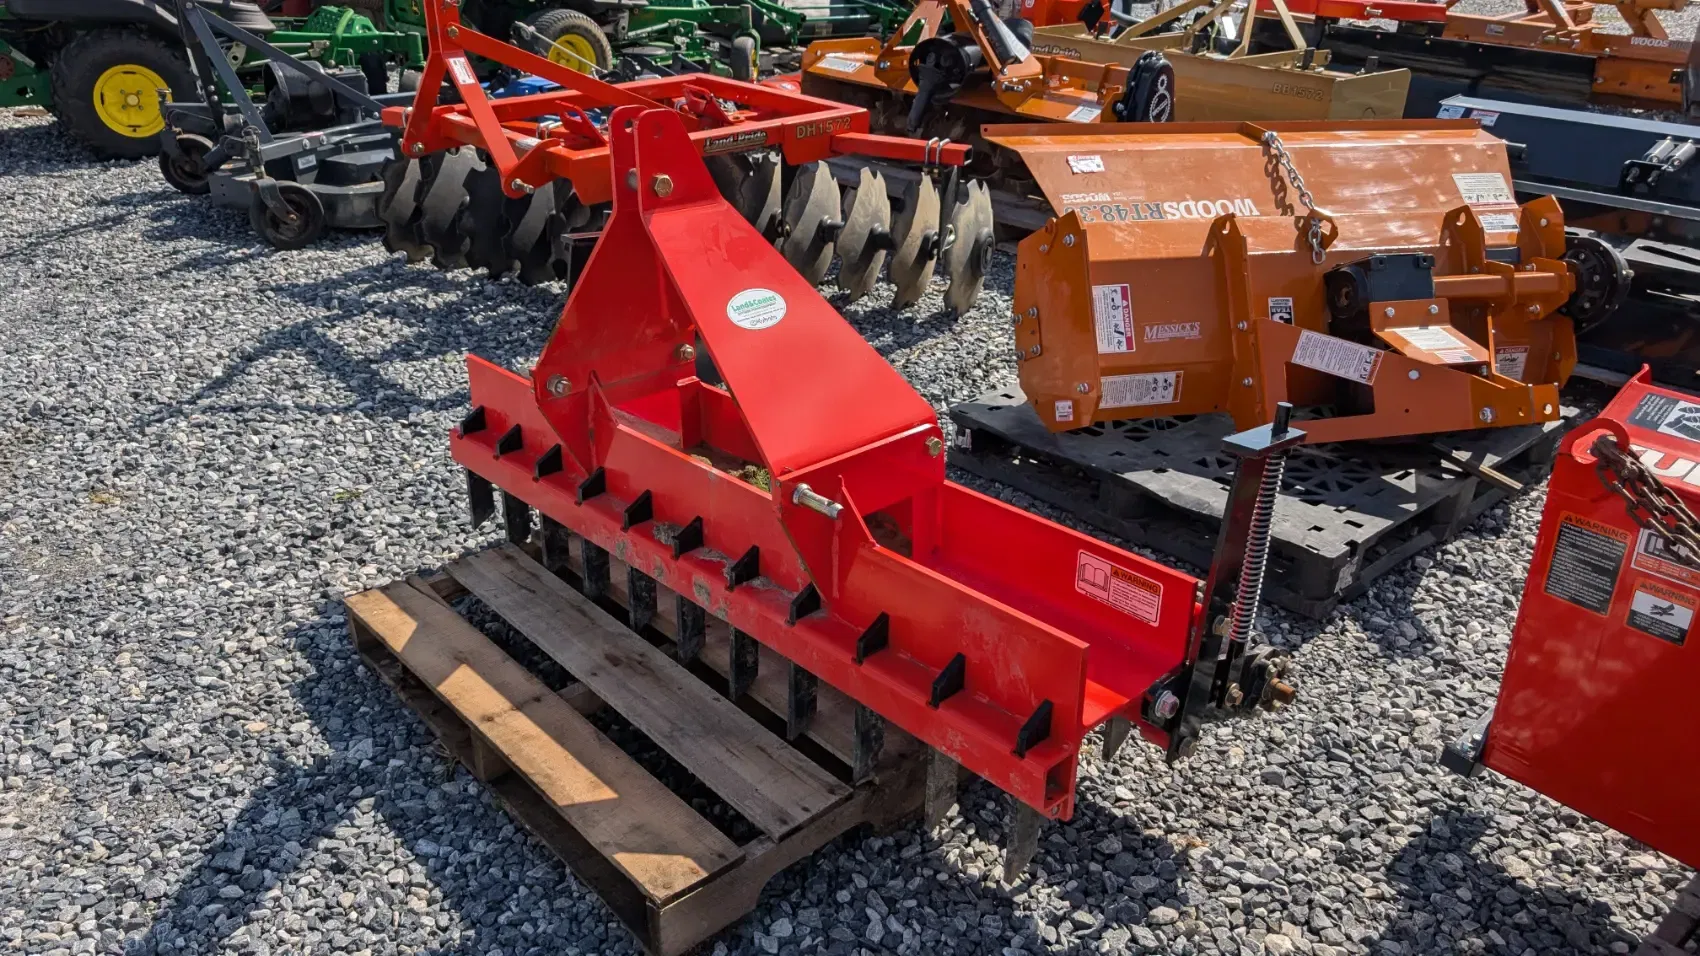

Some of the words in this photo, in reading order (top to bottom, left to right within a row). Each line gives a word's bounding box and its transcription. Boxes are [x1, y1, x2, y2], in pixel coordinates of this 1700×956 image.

[1053, 45, 1081, 57] Pride
[1631, 37, 1670, 48] WOODS
[796, 116, 851, 139] DH1572
[705, 136, 734, 148] Land
[738, 131, 767, 143] Pride
[1061, 191, 1112, 204] WOODS
[1163, 197, 1260, 220] WOODS
[1123, 307, 1132, 338] DANGER
[1143, 321, 1201, 340] MESSICK'S
[1574, 515, 1629, 541] WARNING
[1121, 571, 1158, 593] WARNING
[1648, 584, 1696, 606] WARNING
